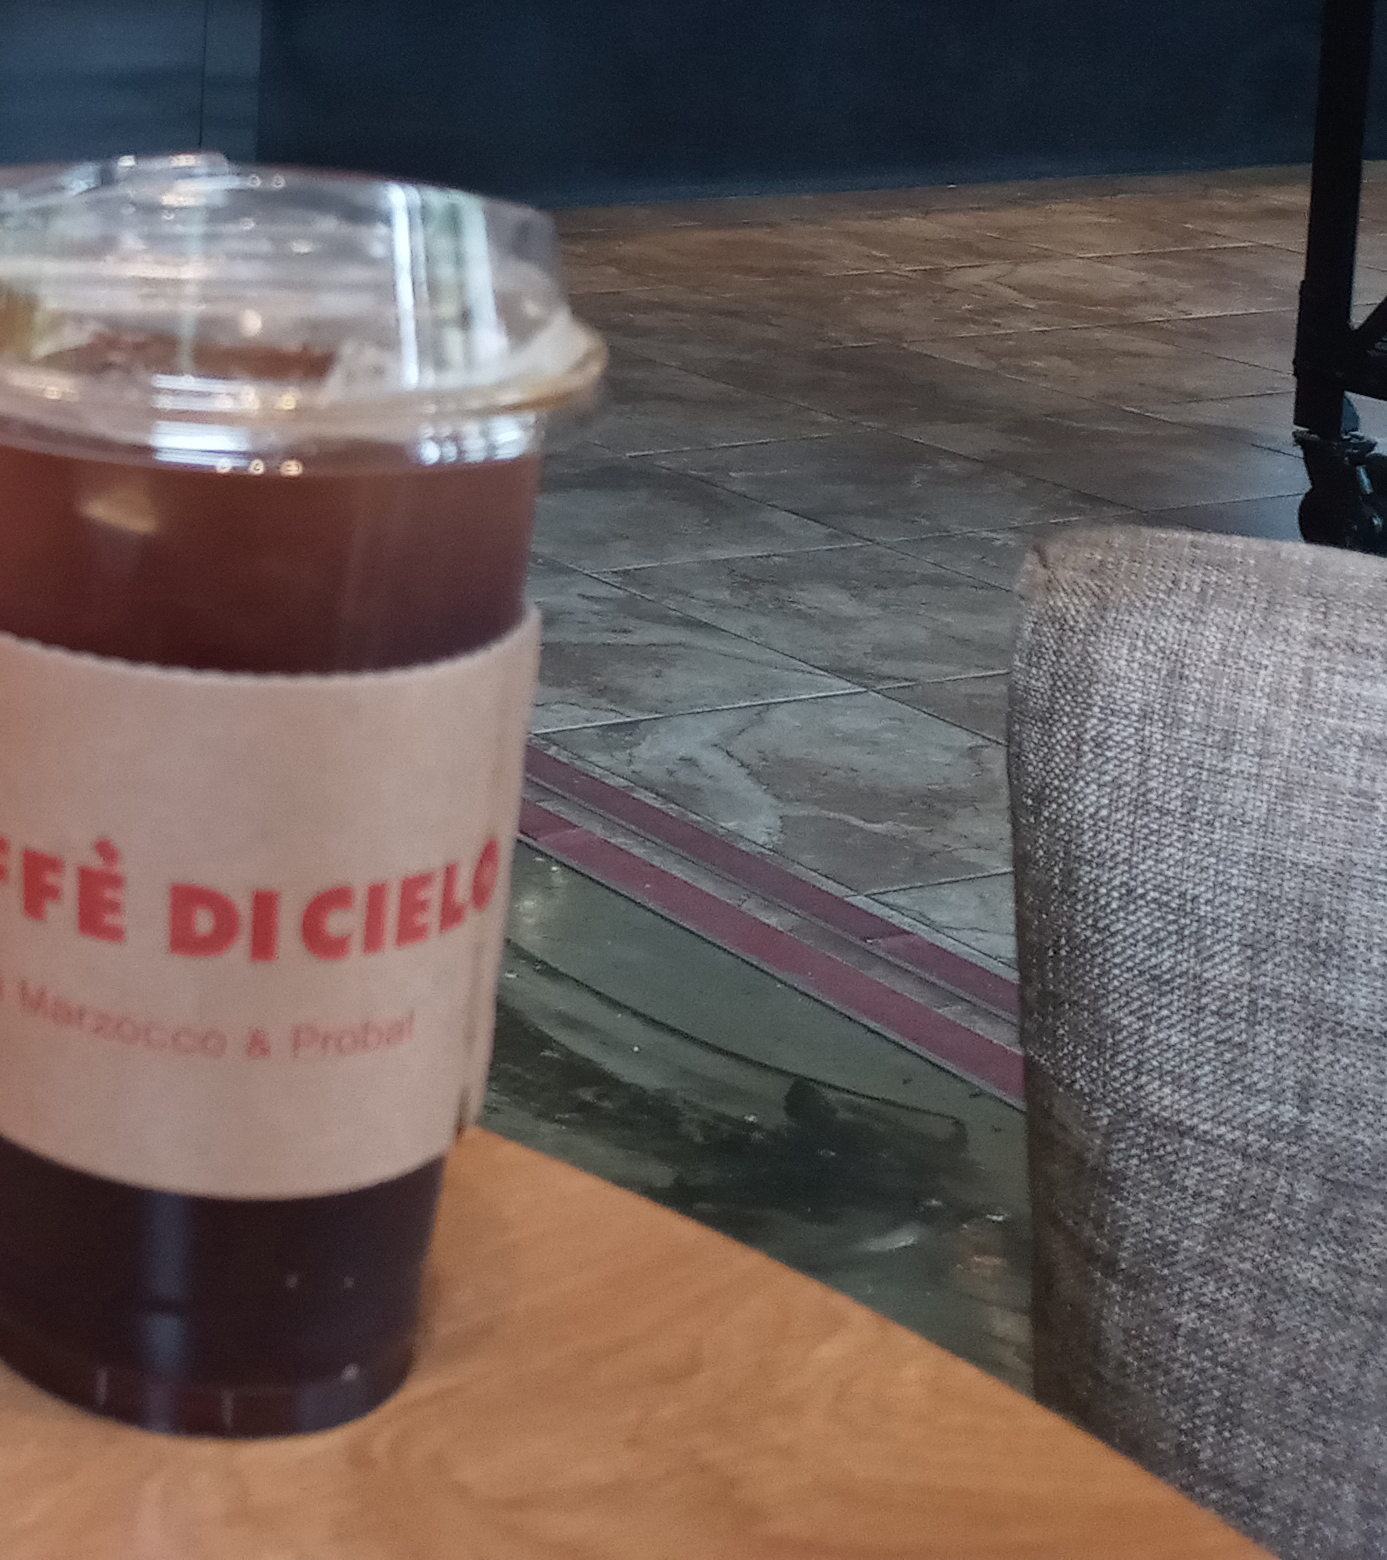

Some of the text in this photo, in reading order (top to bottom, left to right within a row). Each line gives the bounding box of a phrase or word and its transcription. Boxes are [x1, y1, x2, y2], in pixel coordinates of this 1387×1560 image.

[169, 882, 280, 962] DI
[301, 838, 501, 961] CIELO
[19, 980, 226, 1058] Marzocco
[245, 1028, 271, 1059] &
